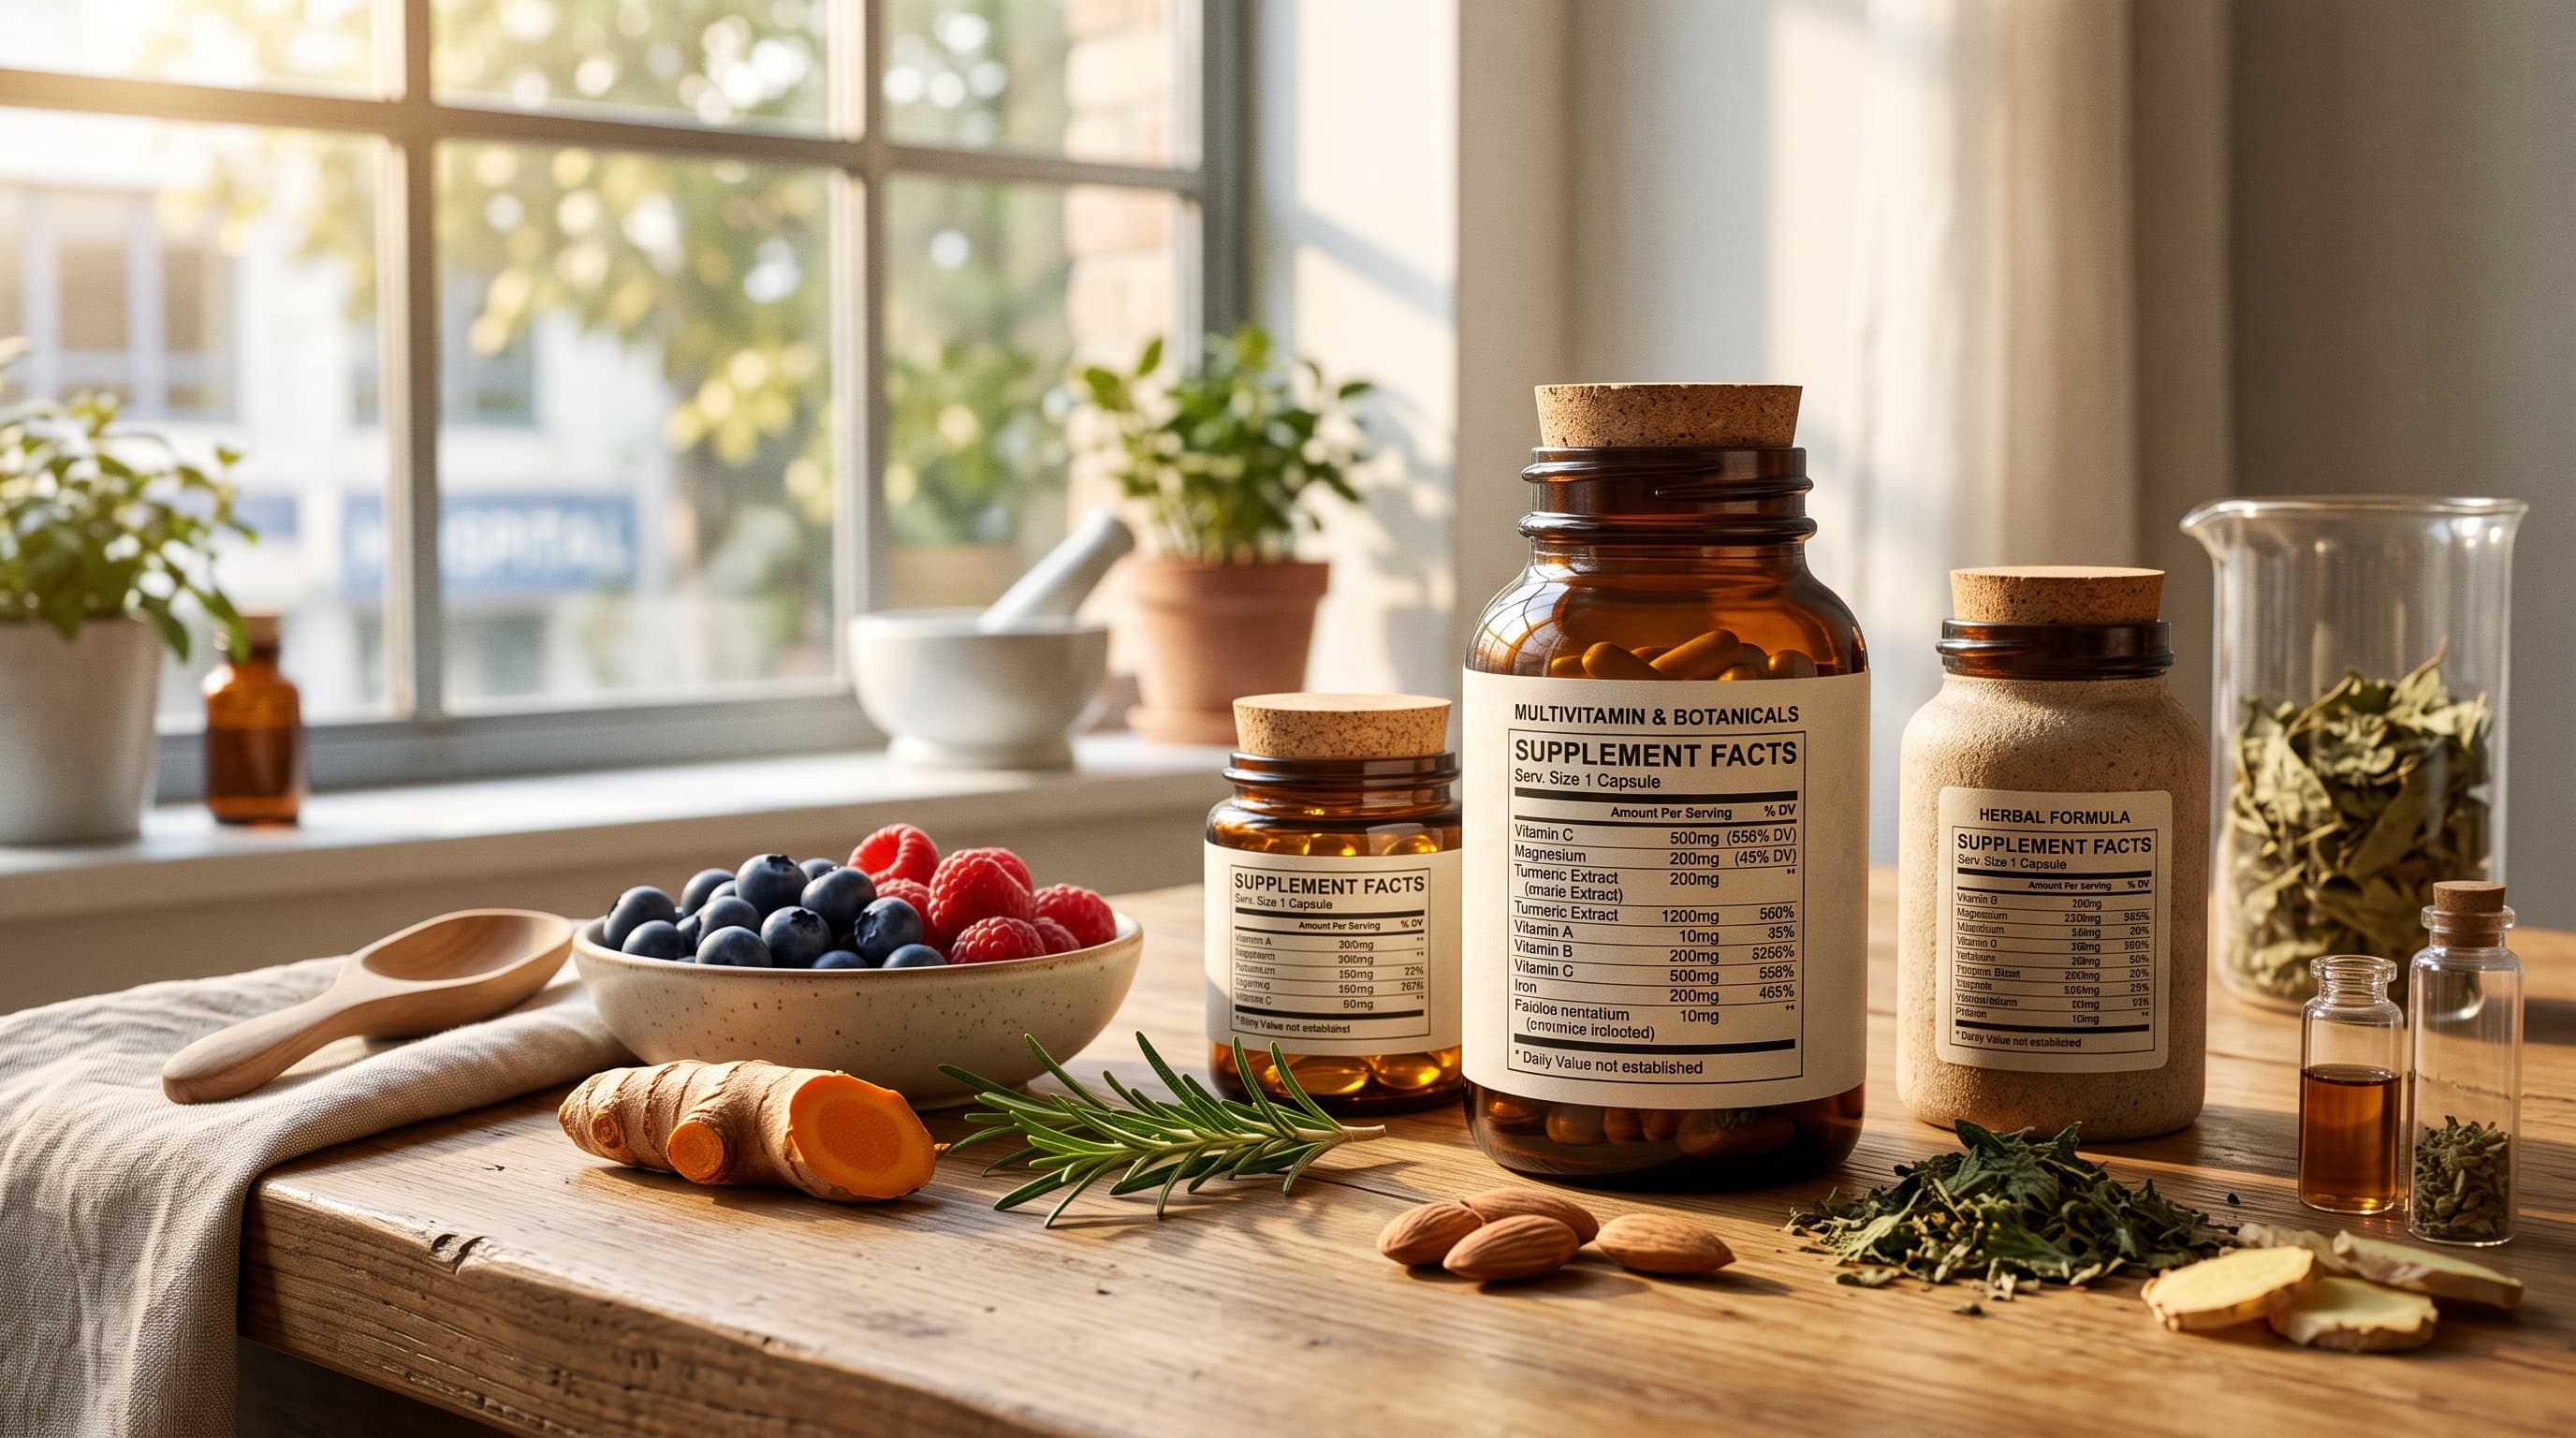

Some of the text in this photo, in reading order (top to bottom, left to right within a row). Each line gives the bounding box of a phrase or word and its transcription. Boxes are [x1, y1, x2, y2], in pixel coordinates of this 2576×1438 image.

[1515, 703, 1799, 726] MULTIVITAMIN & BOTANICALS
[1515, 739, 1797, 768] SUPPLEMENT FACTS
[1515, 768, 1661, 791] Serv. Size 1 Capsule
[1611, 803, 1796, 821] Amount Per Serving % DV
[1980, 808, 2130, 825] HERBAL FORMULA
[1515, 824, 1796, 847] Vitamin C 500mg (556% DV)
[1958, 833, 2152, 855] SUPPLEMENT FACTS
[1515, 844, 1796, 868] Magnesium 200mg (45% DV)
[2011, 858, 2016, 868] 1
[2020, 858, 2067, 872] Capsule
[1235, 873, 1425, 895] SUPPLEMENT FACTS
[1515, 864, 1720, 888] Turmeric Extract 200mg
[2028, 881, 2062, 890] Amount
[2065, 882, 2078, 890] Per
[2127, 880, 2135, 888] %
[1257, 896, 1277, 907] Size
[1281, 899, 1285, 907] 1
[1289, 898, 1333, 911] Capsule
[1572, 887, 1623, 904] Extract)
[1515, 901, 1794, 925] Turmeric Extract 1200mg 560%
[1298, 921, 1330, 930] Amount
[1349, 922, 1381, 931] Serving
[1515, 920, 1559, 938] Vitamin
[1563, 925, 1573, 939] A
[1680, 930, 1720, 946] 10mg
[1266, 937, 1272, 946] A
[1515, 940, 1559, 957] Vitamin
[1563, 945, 1573, 958] B
[1670, 949, 1720, 965] 200mg
[2130, 955, 2149, 964] 50%
[1515, 960, 1559, 976] Vitamin
[1563, 964, 1573, 977] C
[1670, 969, 1720, 985] 500mg
[1266, 996, 1272, 1005] C
[1515, 978, 1794, 1005] Iron 200mg 465%
[1561, 1006, 1630, 1021] nentatium
[1680, 1009, 1720, 1025] 10mg
[1986, 1034, 2011, 1045] Value
[2012, 1038, 2028, 1047] not
[1523, 1050, 1703, 1075] Daily Value not established
